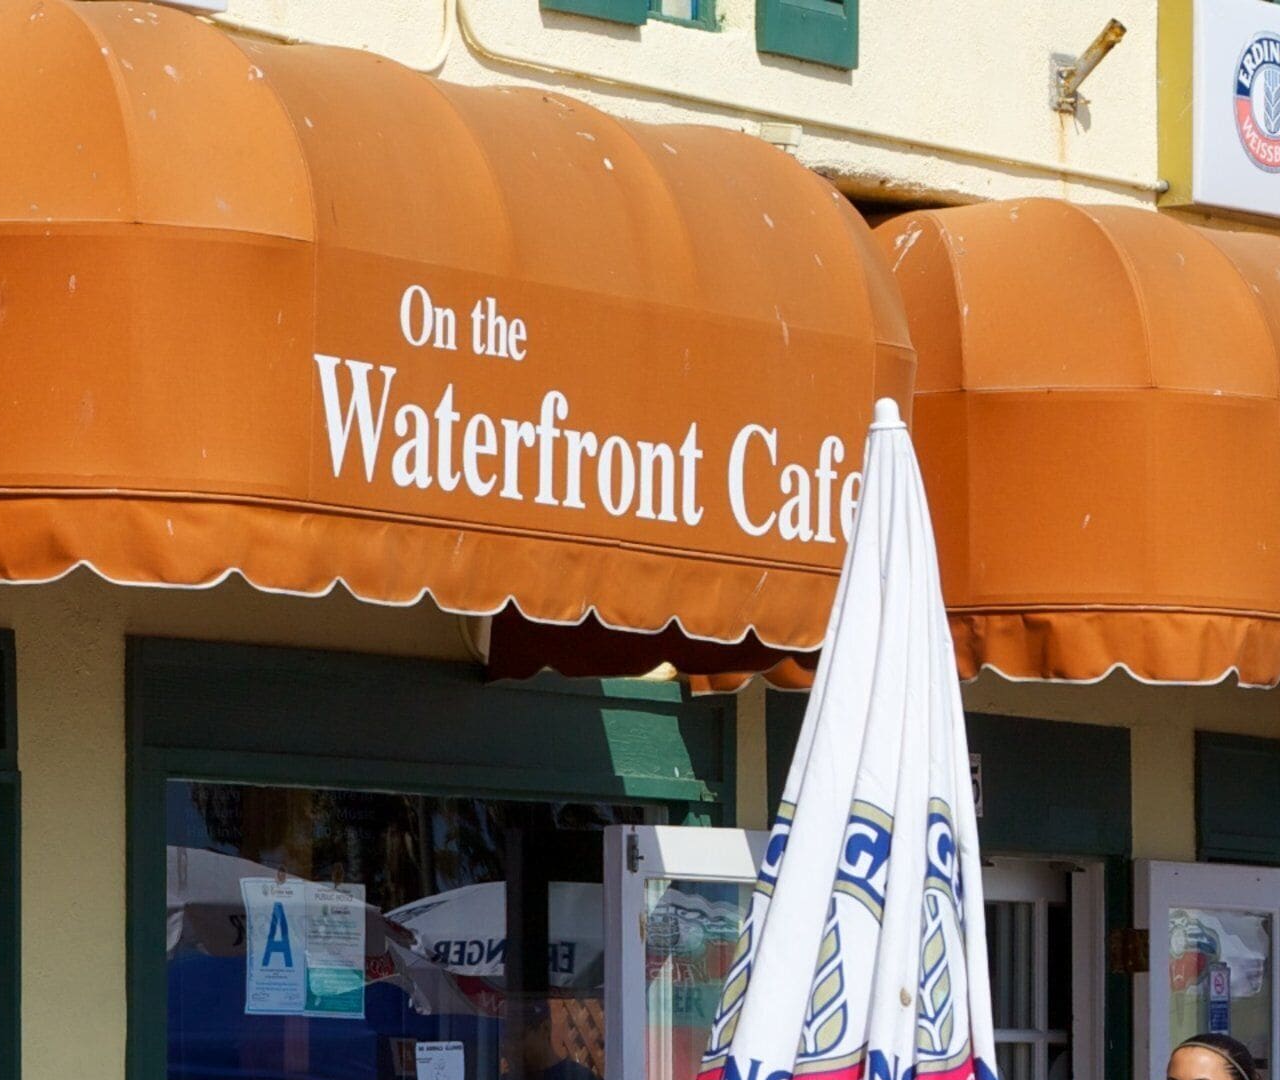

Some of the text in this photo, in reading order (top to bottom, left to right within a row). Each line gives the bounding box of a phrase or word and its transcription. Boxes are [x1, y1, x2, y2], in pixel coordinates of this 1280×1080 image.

[400, 284, 528, 361] On the
[314, 353, 705, 526] Waterfront
[261, 901, 294, 968] A
